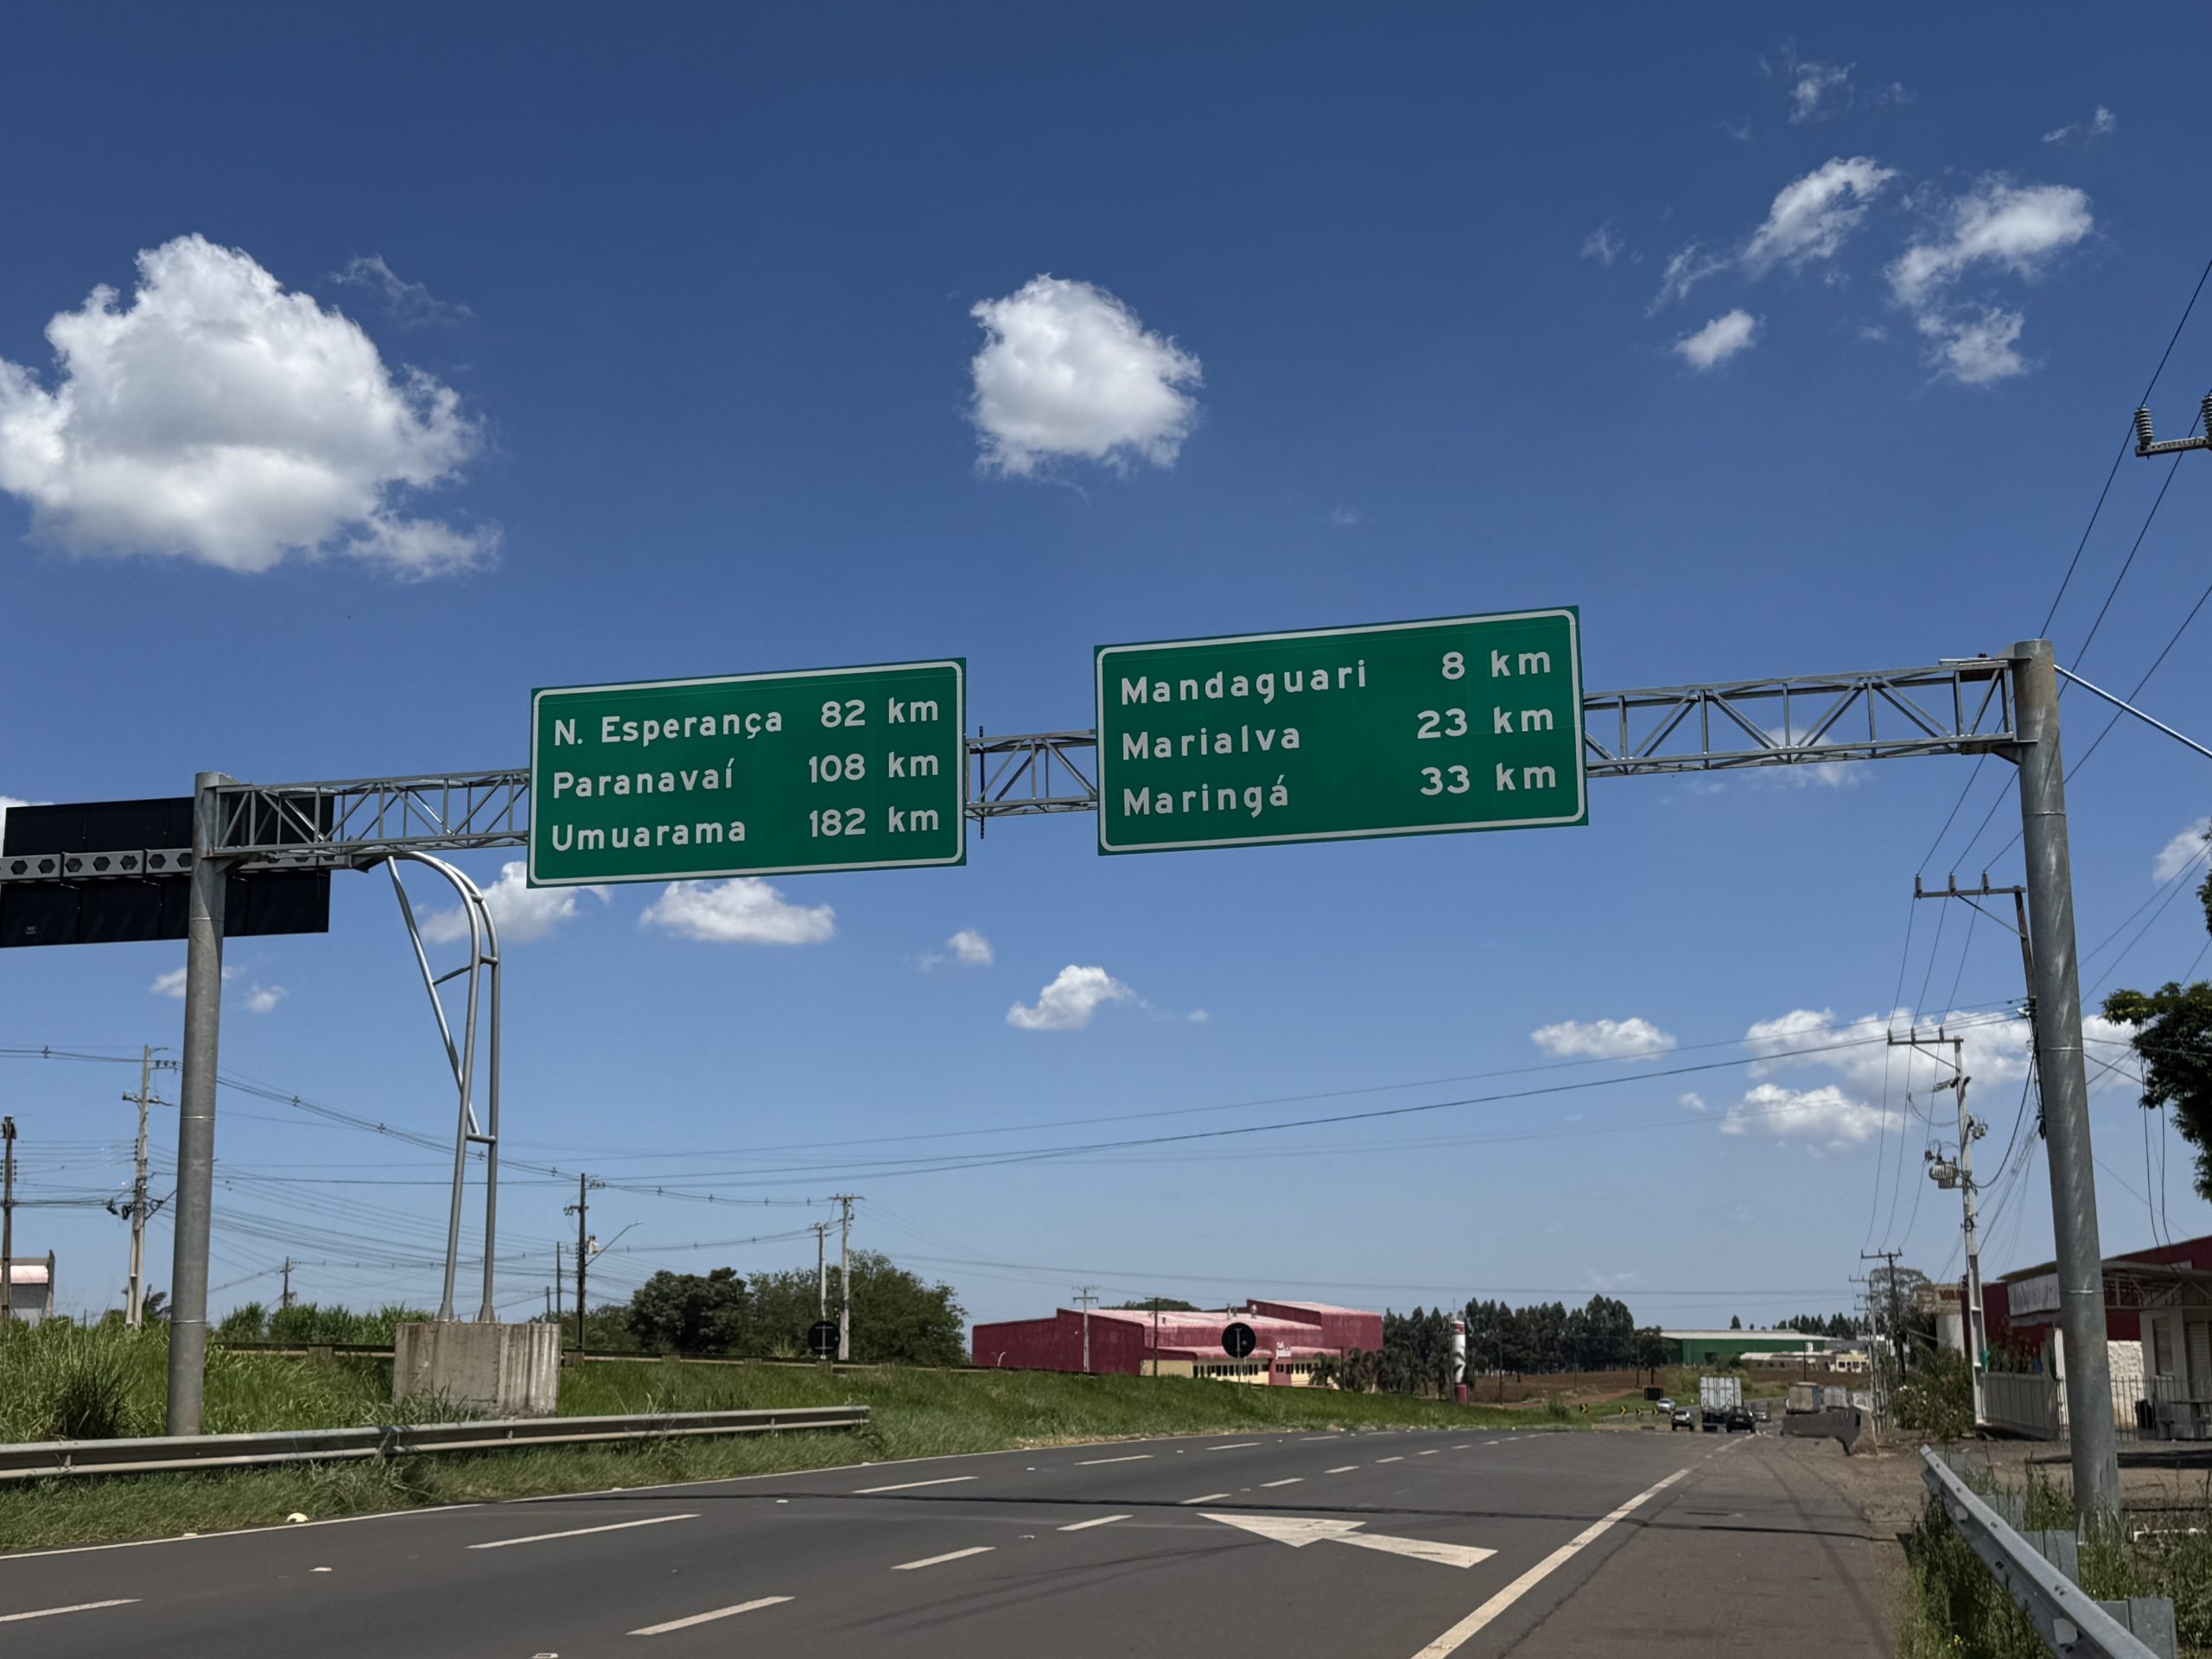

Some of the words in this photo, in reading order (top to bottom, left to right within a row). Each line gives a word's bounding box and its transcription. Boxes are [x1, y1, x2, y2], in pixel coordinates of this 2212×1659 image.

[1121, 659, 1366, 706] Mandaguari
[1441, 652, 1465, 680] 8
[1491, 649, 1551, 677] km
[554, 718, 583, 747] N.
[601, 711, 782, 747] Esperança
[821, 699, 866, 728] 82
[888, 696, 938, 724] km
[1122, 724, 1300, 760] Marialva
[1417, 708, 1468, 740] 23
[1493, 706, 1554, 734] km
[553, 757, 734, 799] Paranavaí
[809, 753, 866, 783] 108
[888, 751, 938, 779] km
[1123, 774, 1288, 818] Maringá
[1420, 765, 1470, 796] 33
[1496, 762, 1556, 791] km
[552, 821, 746, 852] Umuarama
[809, 807, 866, 837] 182
[888, 805, 938, 833] km
